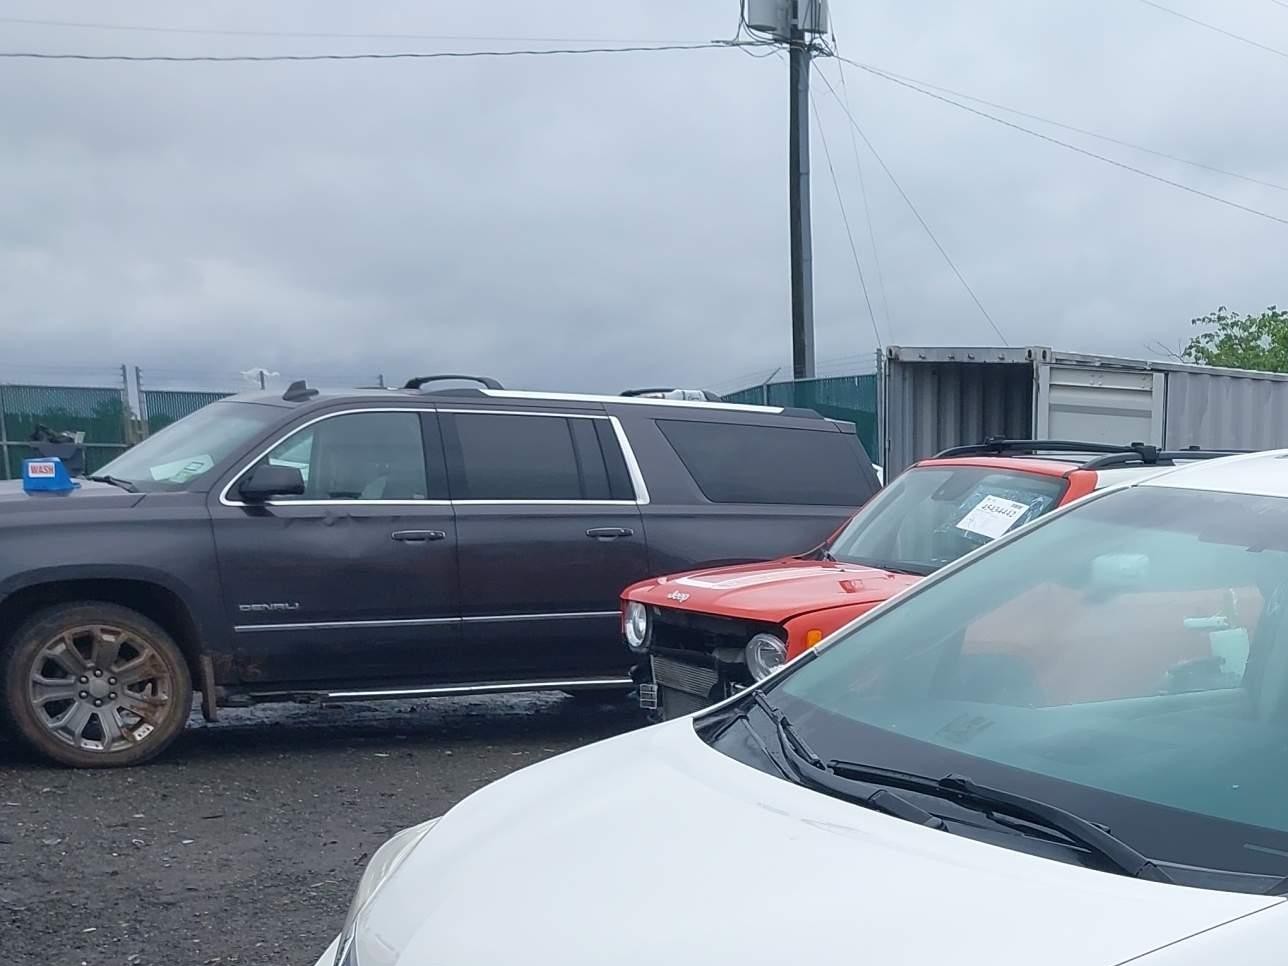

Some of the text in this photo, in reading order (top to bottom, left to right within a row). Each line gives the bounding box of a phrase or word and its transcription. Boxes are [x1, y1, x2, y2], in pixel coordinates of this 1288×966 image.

[30, 464, 54, 474] WASH
[667, 590, 690, 603] Jeep
[239, 602, 300, 612] DENALI
